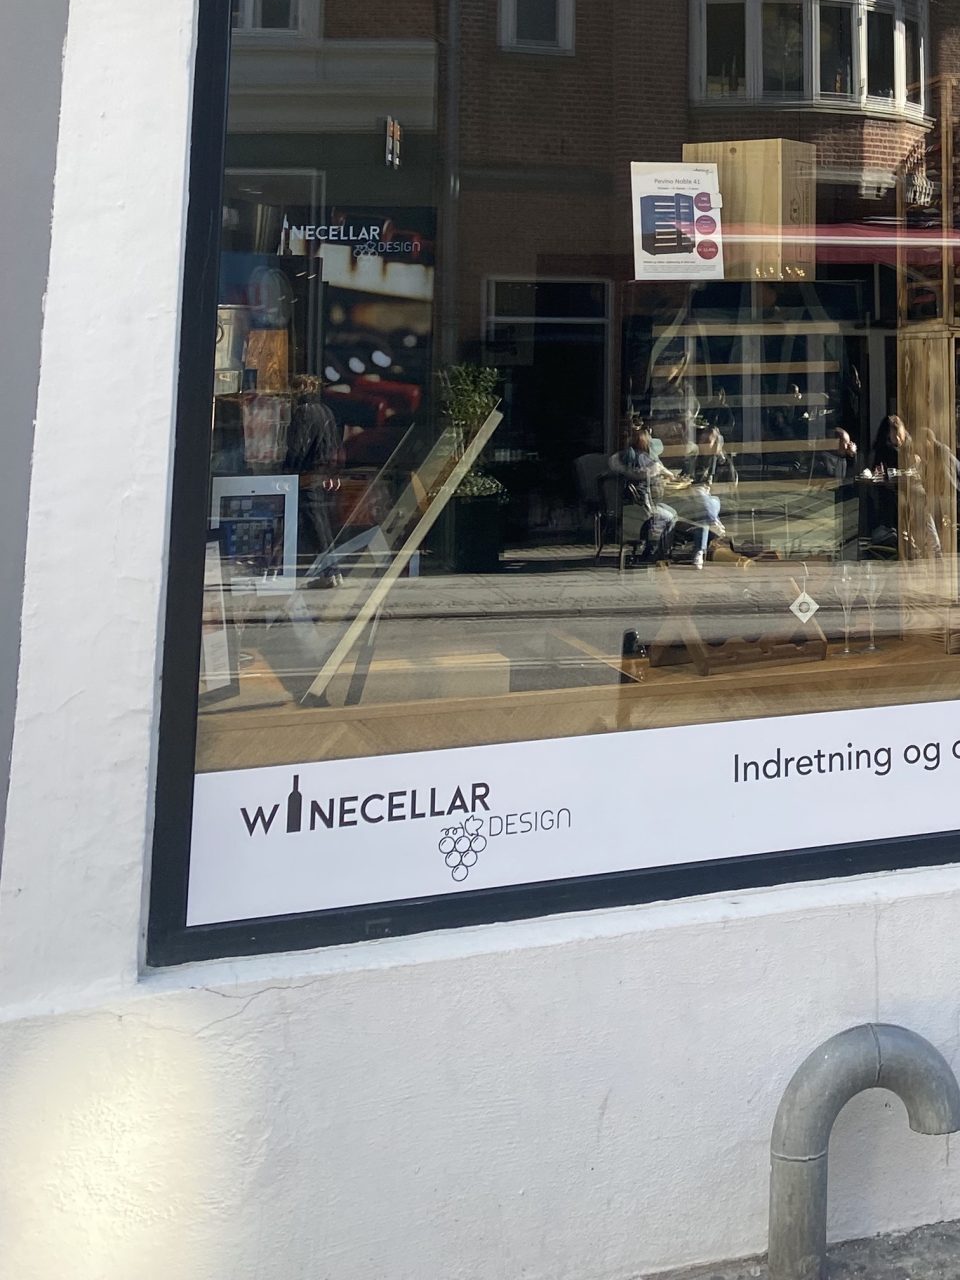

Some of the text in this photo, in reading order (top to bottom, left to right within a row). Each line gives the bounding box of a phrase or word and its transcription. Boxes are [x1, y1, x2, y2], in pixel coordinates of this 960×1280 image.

[734, 741, 893, 783] Indretning
[903, 742, 941, 772] og
[240, 774, 490, 836] WINECELLAR
